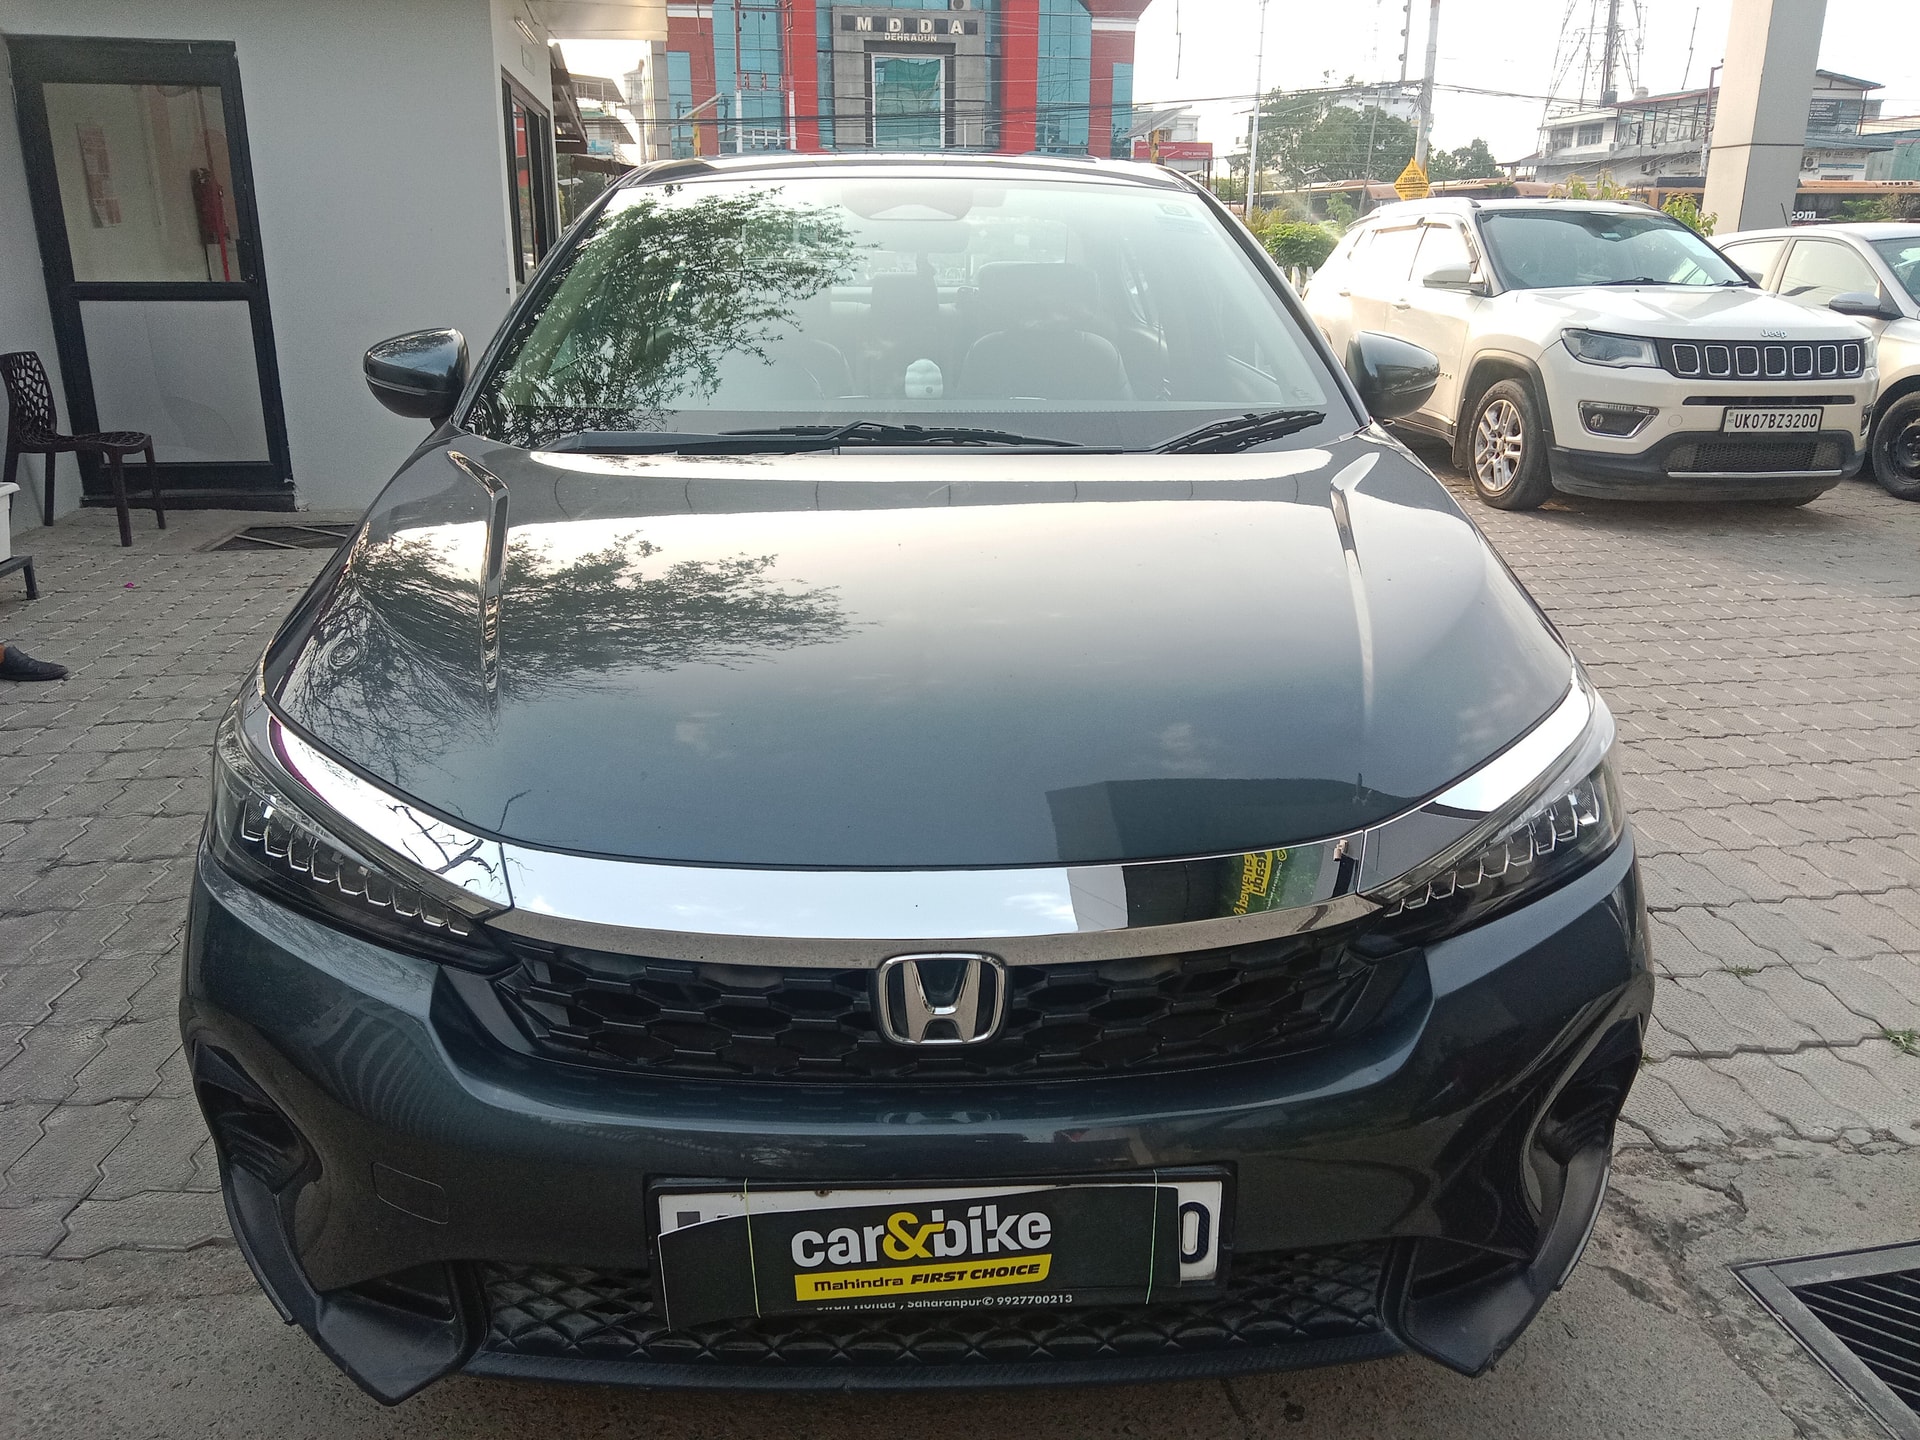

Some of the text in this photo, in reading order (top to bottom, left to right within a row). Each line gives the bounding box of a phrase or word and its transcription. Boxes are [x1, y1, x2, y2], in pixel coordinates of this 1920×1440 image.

[884, 32, 937, 42] DEHRADUN
[1761, 329, 1787, 339] Jeep
[1734, 413, 1818, 429] UK07BZ3200
[791, 1204, 1052, 1268] car&bike
[814, 1263, 1041, 1292] Mahindra FIRST CHOICE
[907, 1298, 982, 1309] Saharanpur
[996, 1294, 1073, 1306] 9927700213
